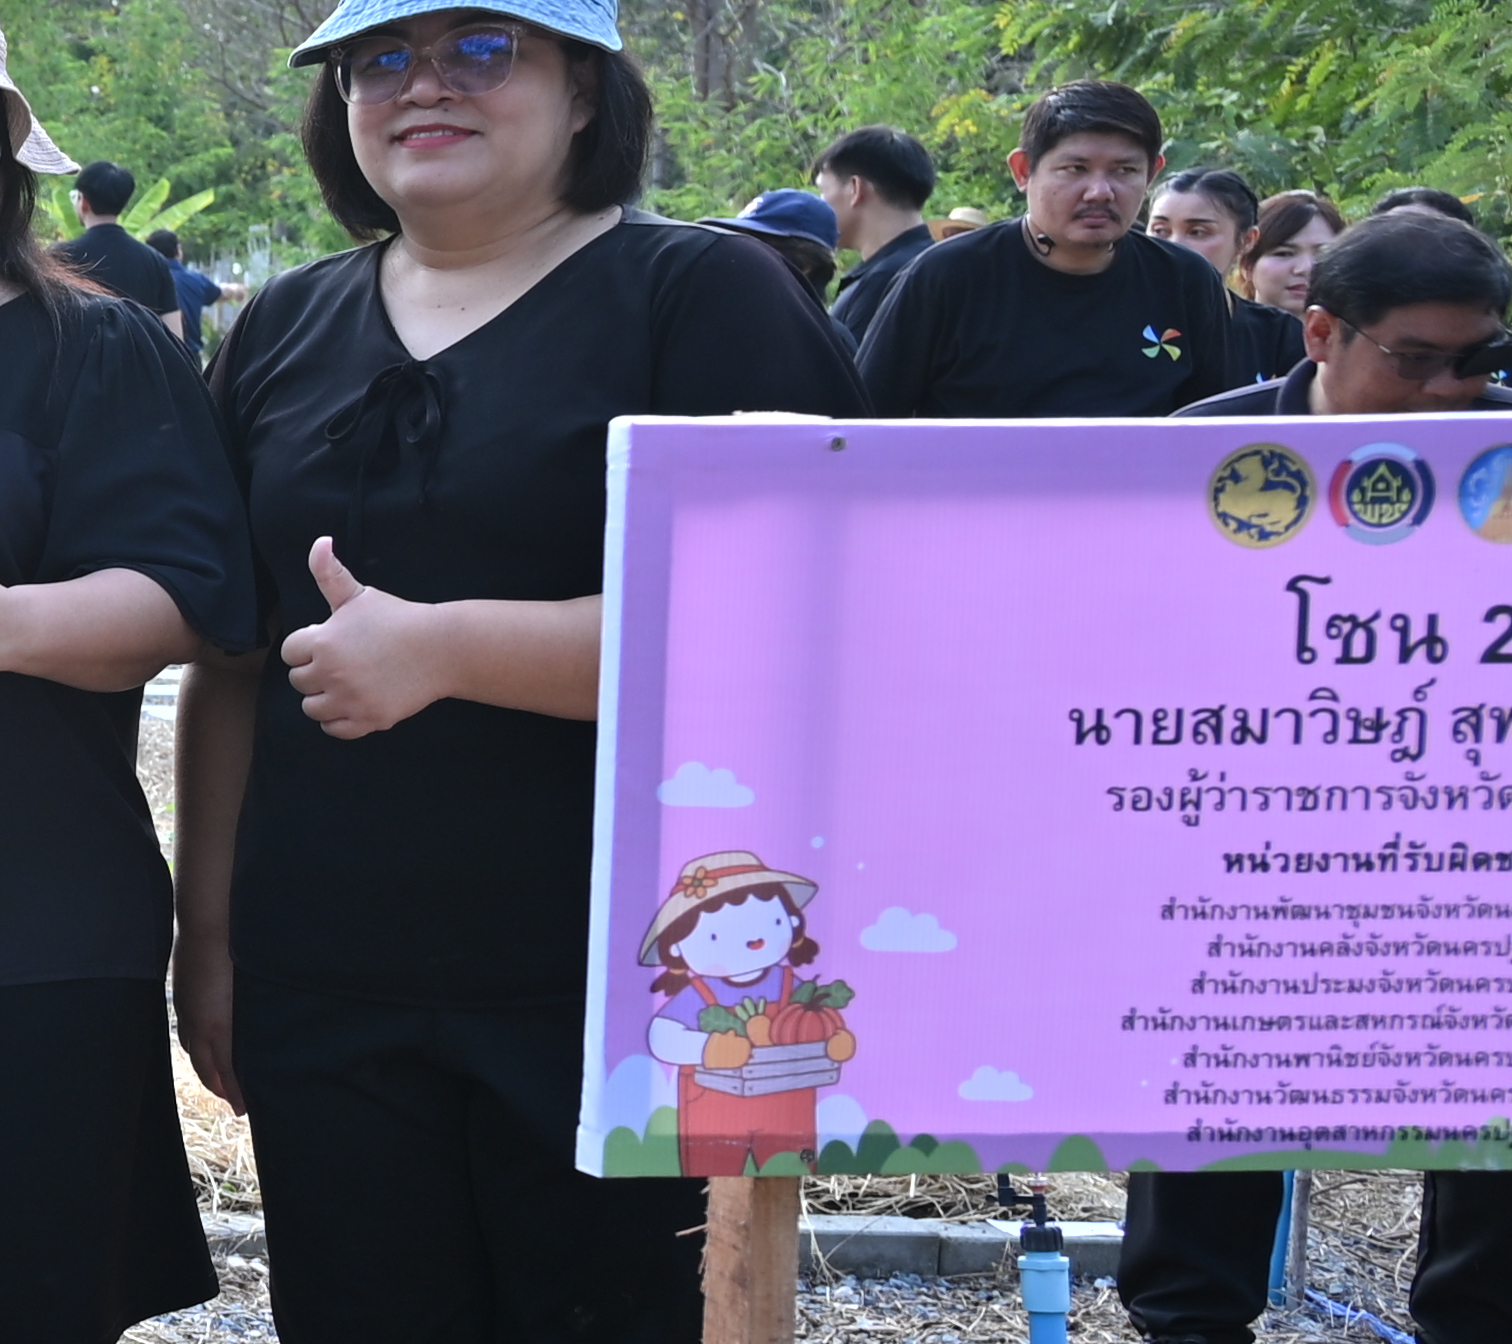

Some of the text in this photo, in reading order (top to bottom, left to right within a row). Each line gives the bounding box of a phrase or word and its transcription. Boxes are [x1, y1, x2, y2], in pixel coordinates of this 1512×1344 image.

[1285, 574, 1449, 665] โซน
[1068, 678, 1437, 763] นายสมาวิษฎ์
